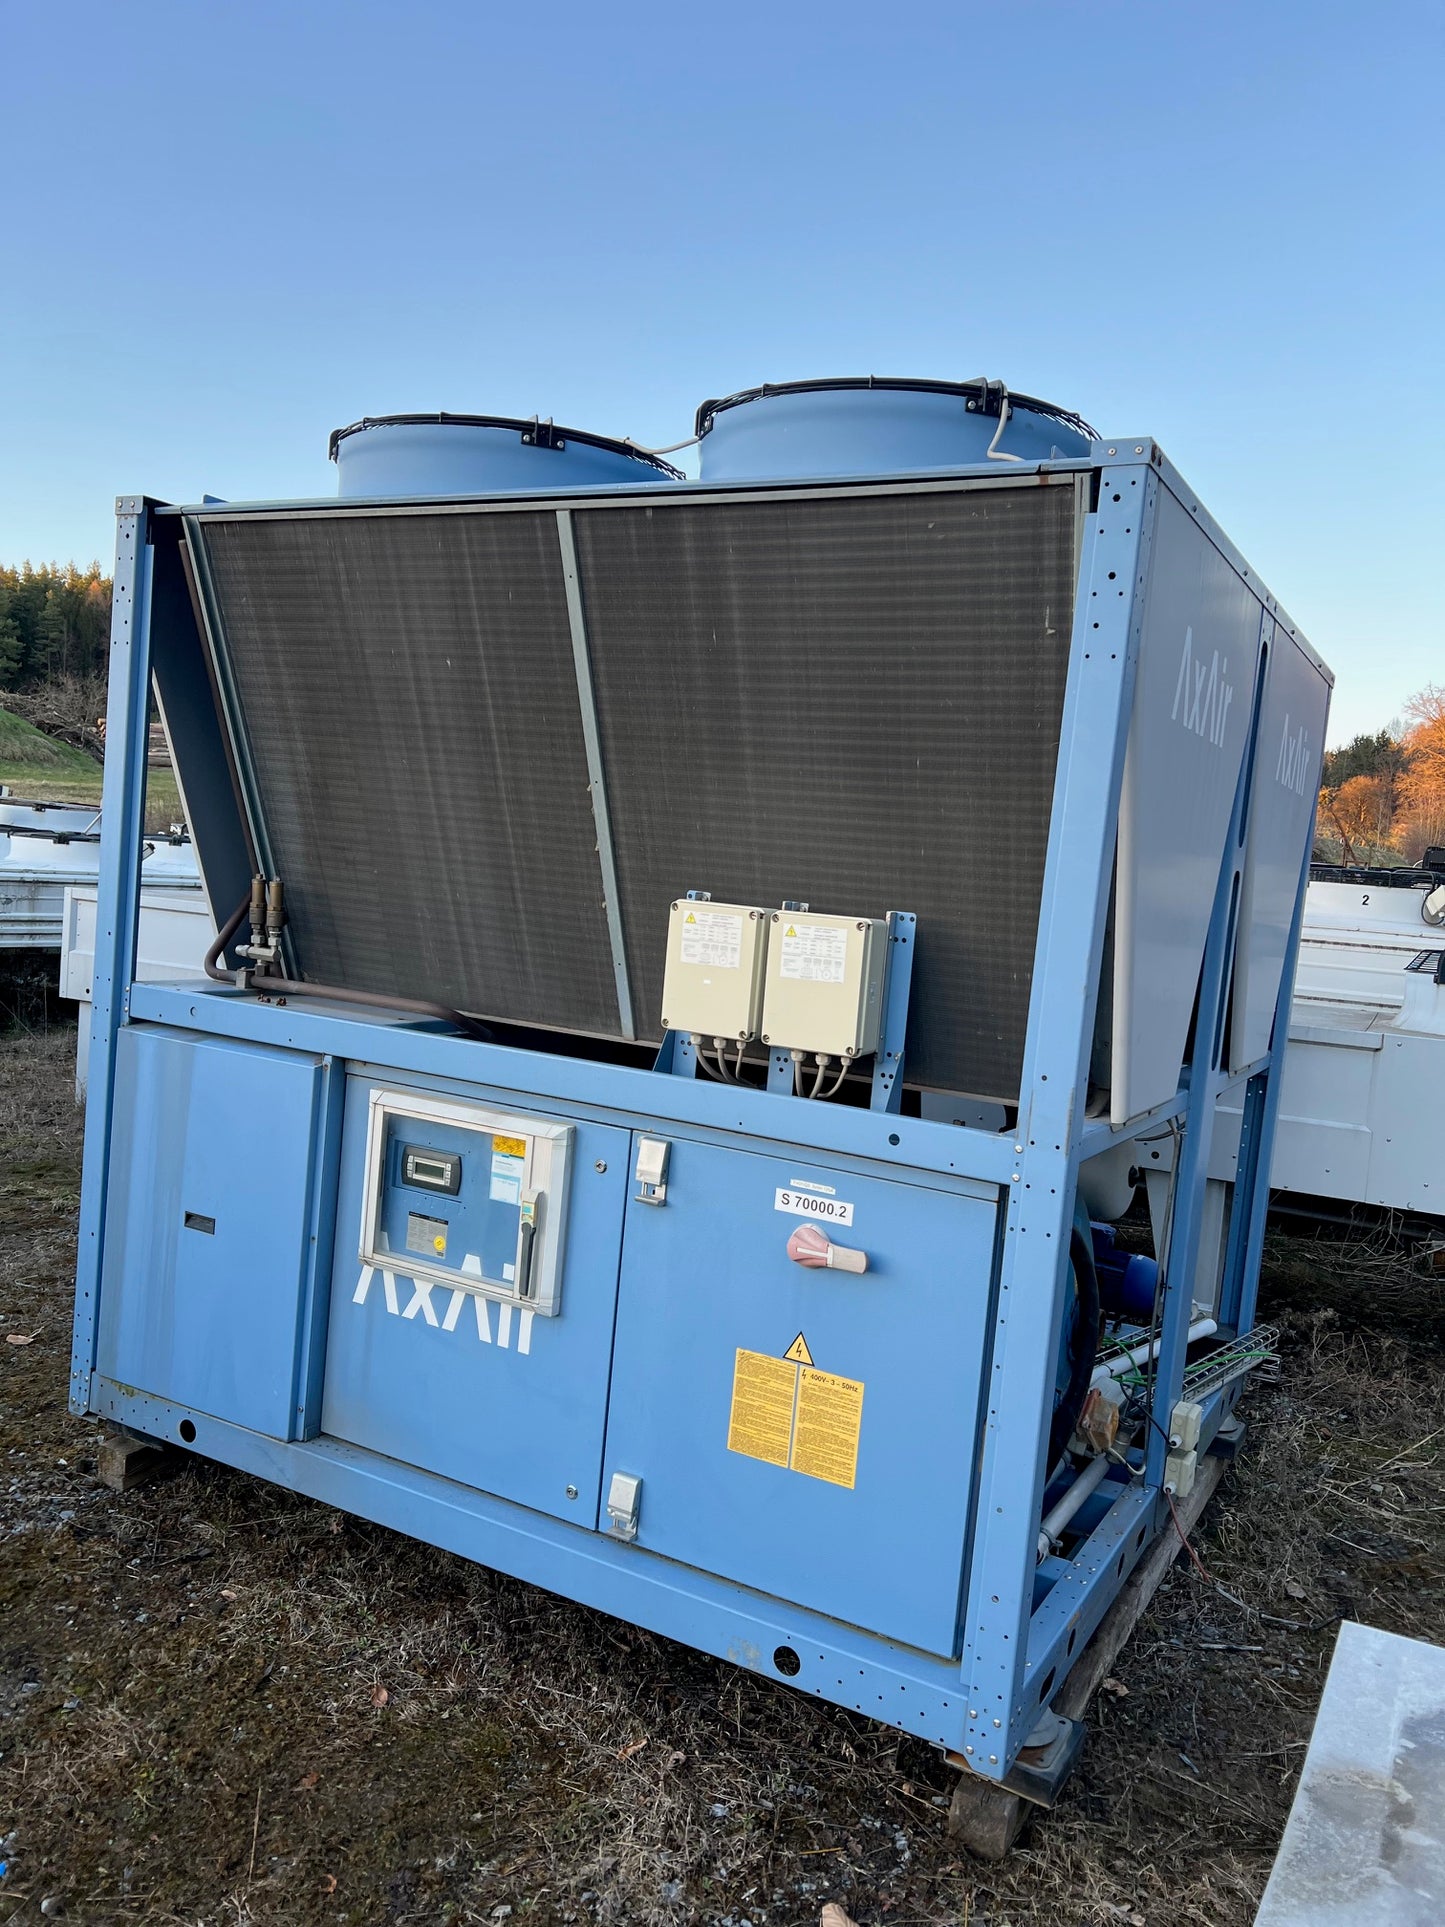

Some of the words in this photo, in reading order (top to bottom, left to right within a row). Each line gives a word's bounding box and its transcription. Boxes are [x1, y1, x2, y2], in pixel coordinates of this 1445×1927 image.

[1171, 625, 1233, 748] AxAir
[1275, 713, 1310, 796] AxAir
[1361, 894, 1370, 906] 2
[781, 1193, 790, 1205] S
[795, 1195, 847, 1218] 70000.2
